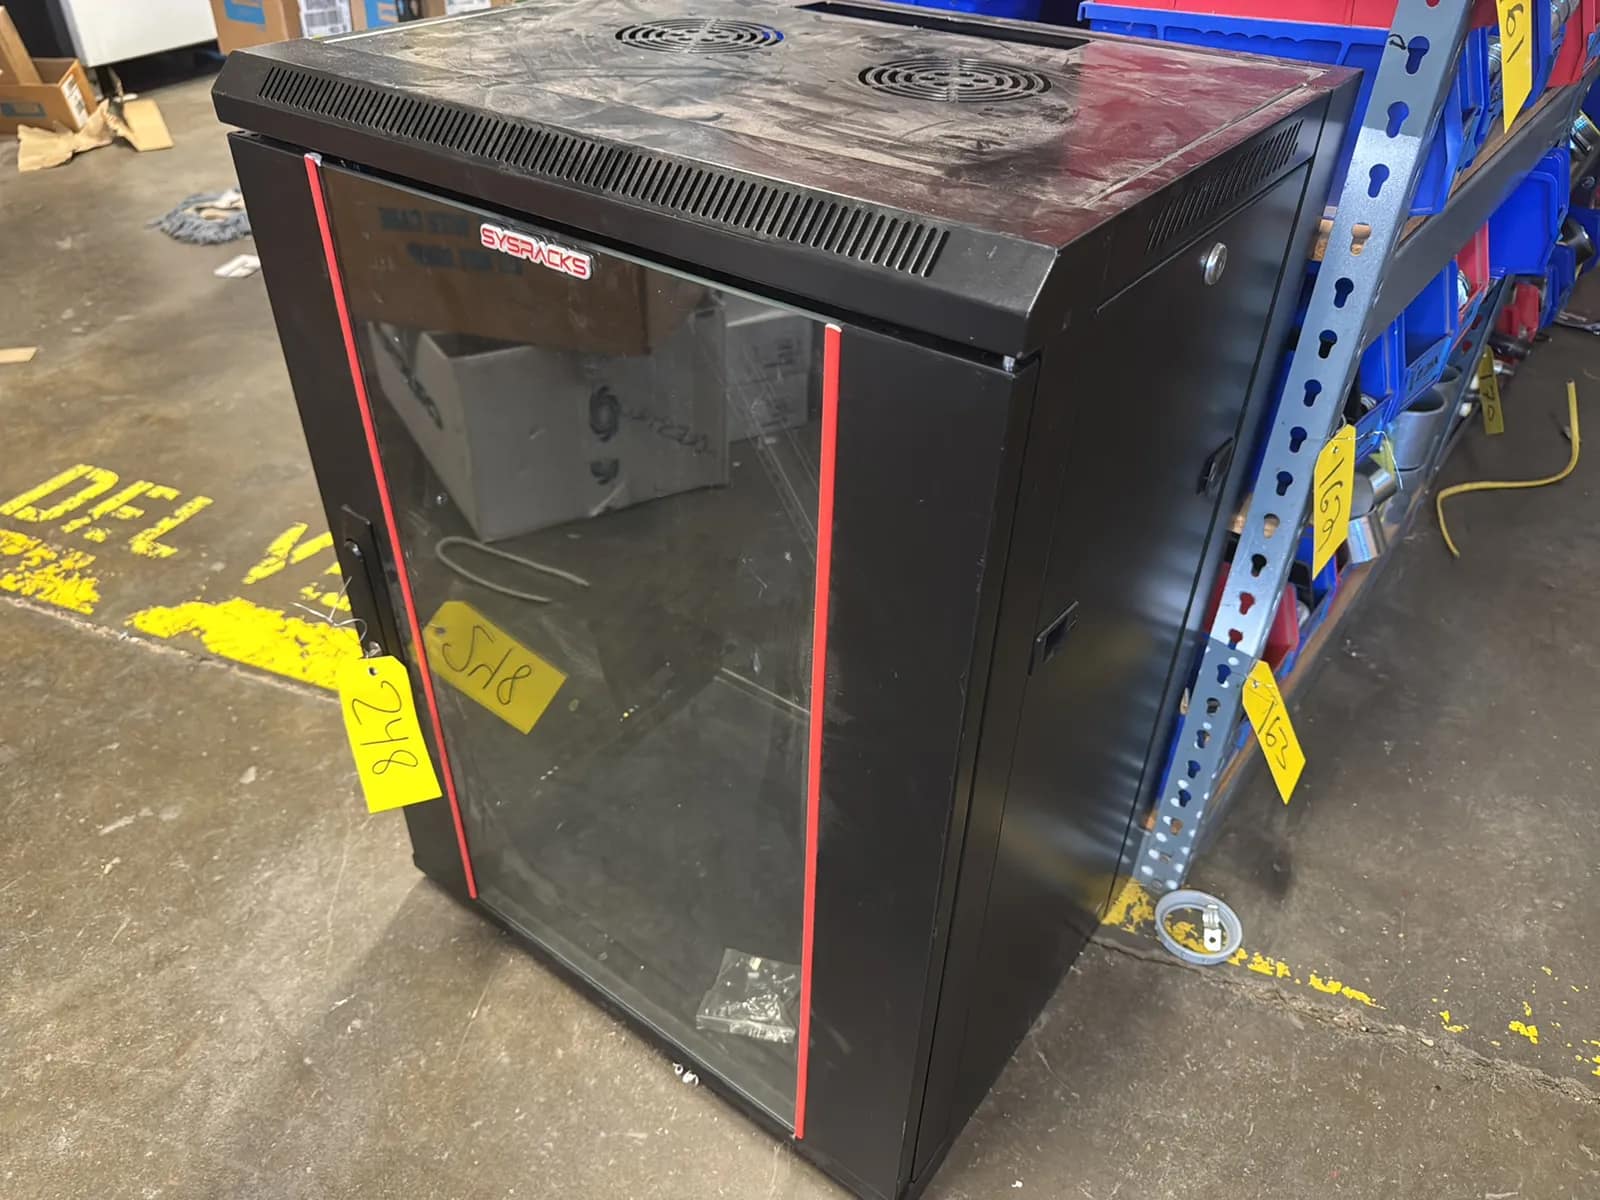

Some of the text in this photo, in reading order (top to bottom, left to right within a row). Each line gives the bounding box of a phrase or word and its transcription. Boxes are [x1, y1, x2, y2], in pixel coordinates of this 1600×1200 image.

[481, 225, 589, 278] SYSRACKS
[352, 680, 418, 775] 248
[1257, 703, 1290, 770] 163
